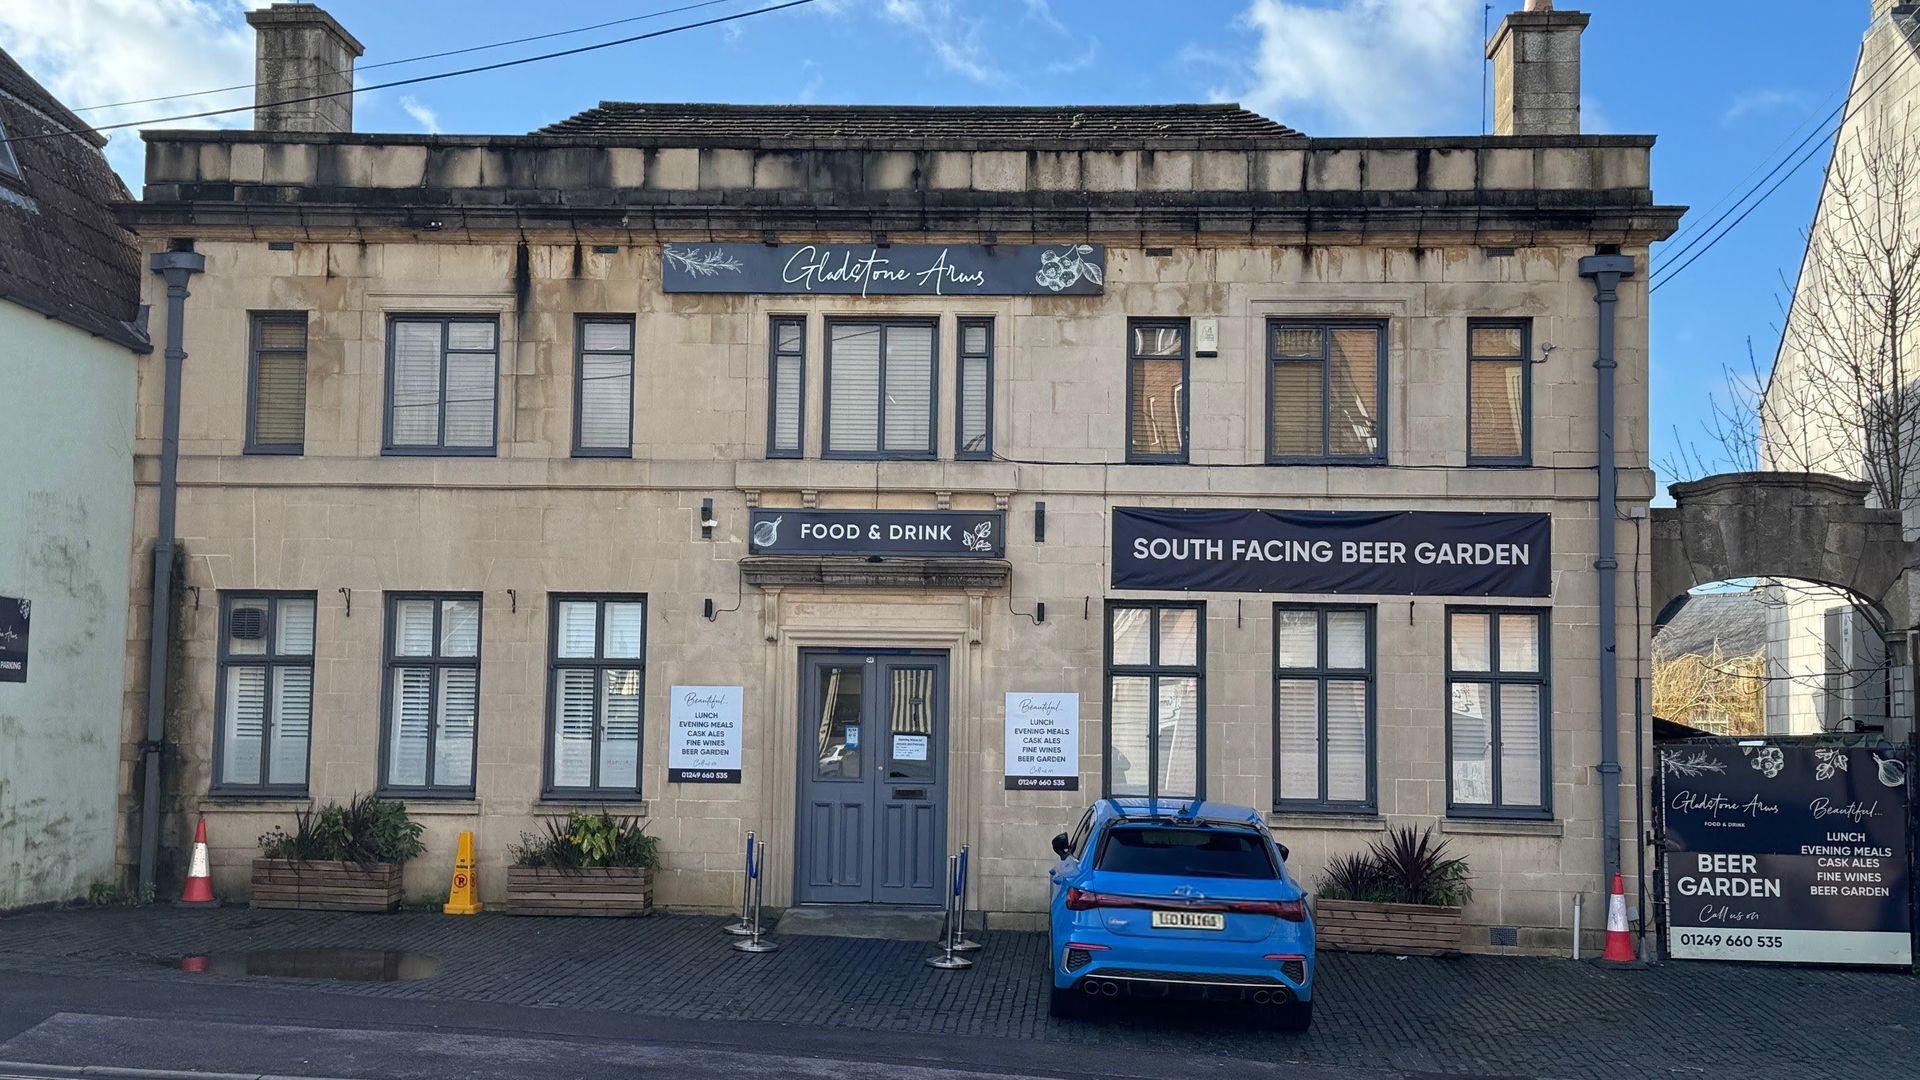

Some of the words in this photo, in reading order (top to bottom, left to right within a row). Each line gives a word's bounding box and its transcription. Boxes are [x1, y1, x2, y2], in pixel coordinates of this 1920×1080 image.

[782, 246, 910, 298] Gladstone
[916, 248, 985, 295] Arms
[801, 523, 860, 540] FOOD
[868, 524, 881, 540] &
[889, 524, 952, 541] DRINK
[1133, 537, 1223, 561] SOUTH
[1232, 539, 1332, 563] FACING
[1341, 541, 1406, 564] BEER
[1414, 542, 1529, 566] GARDEN
[700, 748, 729, 756] GARDEN
[1671, 790, 1739, 818] Gladstone
[1742, 793, 1779, 817] Arms
[1826, 832, 1866, 843] LUNCH
[1801, 845, 1850, 857] EVENING
[1854, 846, 1892, 857] MEALS
[1698, 853, 1757, 874] BEER
[1817, 857, 1850, 868] CASK
[1852, 858, 1880, 868] ALES
[1817, 872, 1842, 882] FINE
[1843, 872, 1882, 883] WINES
[1677, 876, 1780, 898] GARDEN
[1810, 885, 1838, 896] BEER
[1841, 886, 1889, 897] GARDEN
[1698, 904, 1728, 923] Call
[1729, 911, 1744, 921] us
[1745, 911, 1759, 921] on
[1680, 934, 1722, 947] 01249
[1726, 934, 1753, 947] 660
[1757, 935, 1783, 948] 535
